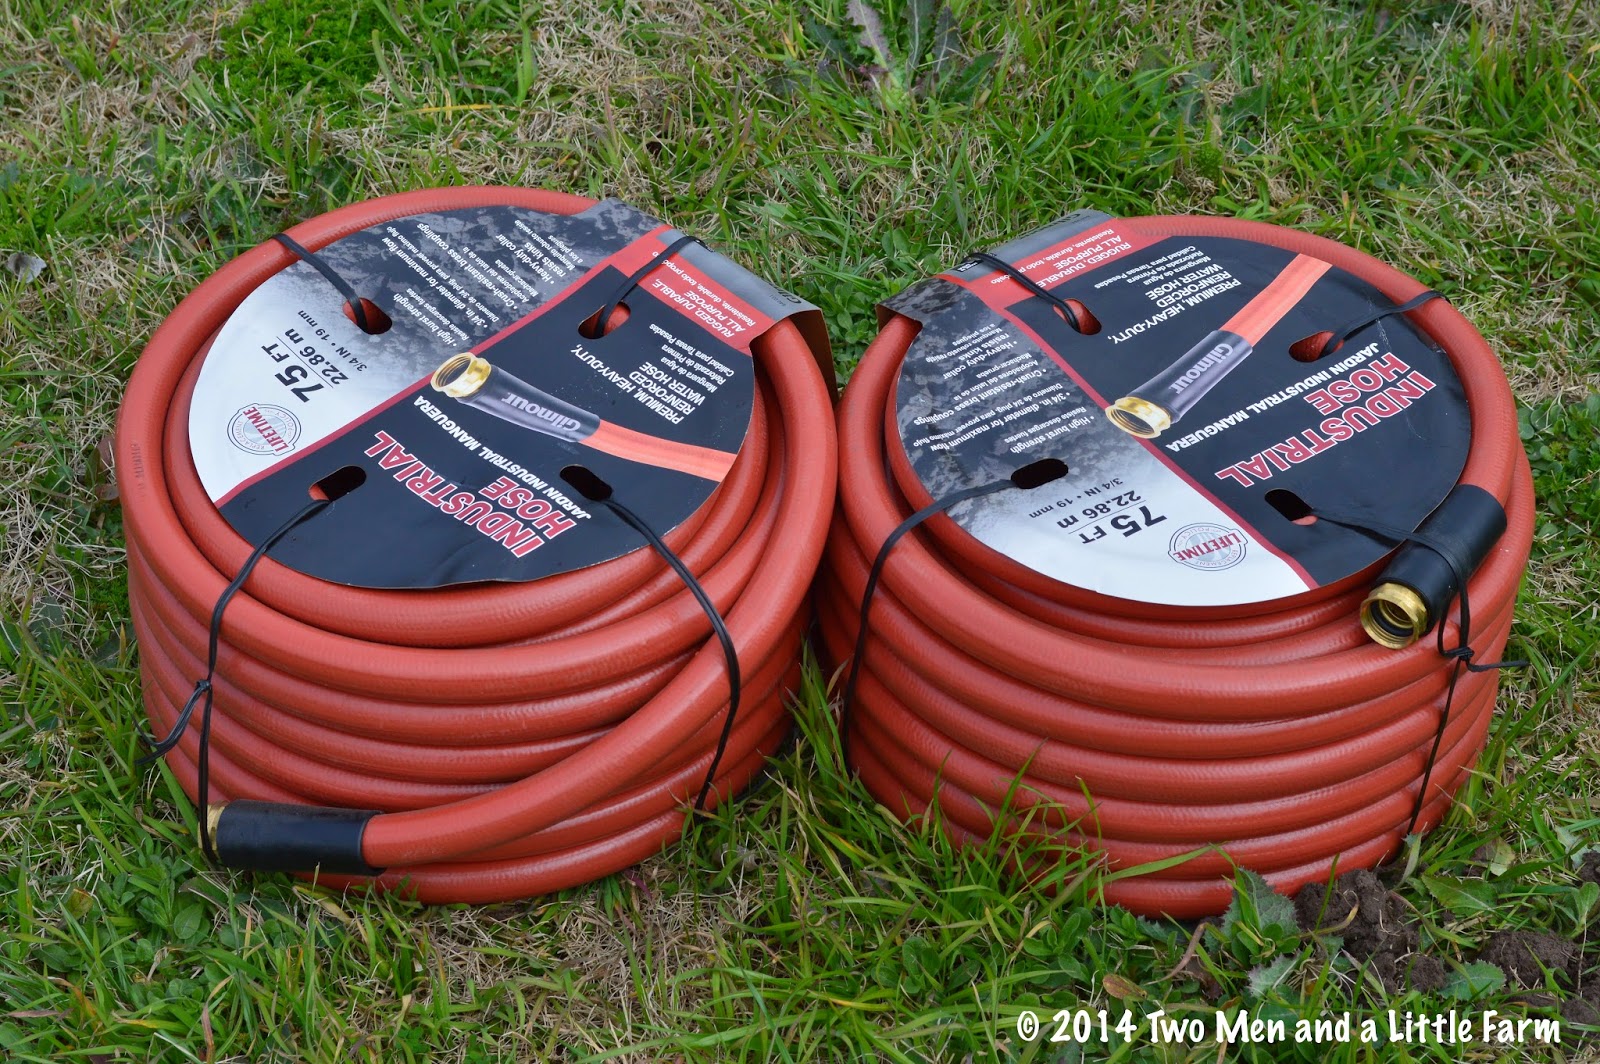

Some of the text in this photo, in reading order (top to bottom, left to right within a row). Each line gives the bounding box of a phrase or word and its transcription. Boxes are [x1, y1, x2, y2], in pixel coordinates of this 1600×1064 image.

[513, 218, 534, 235] resiste
[529, 232, 554, 250] robusto
[415, 222, 516, 307] Crush-resistant brass couplings
[465, 250, 477, 259] de
[492, 233, 553, 282] Heavy-duty collar
[522, 241, 567, 277] resists kinks
[567, 251, 580, 260] los
[1024, 259, 1045, 270] todo
[1051, 234, 1121, 269] ALL PURPOSE
[1083, 241, 1132, 265] RUGGED,
[1093, 244, 1196, 289] Calidad para Tareas Pesadas
[1125, 250, 1203, 283] Reforzada de Primera
[1142, 255, 1211, 286] Manguera de Agua
[380, 236, 486, 326] 3/4 in. diameter for maximum flow
[434, 267, 451, 279] para
[485, 267, 498, 277] del
[679, 272, 697, 286] todo
[1144, 263, 1223, 300] WATER HOSE
[1153, 269, 1232, 308] REINFORCED
[404, 287, 426, 304] fuertes
[466, 295, 478, 304] de
[651, 278, 735, 338] RUGGED, DURABLE,
[682, 289, 746, 332] ALL PURPOSE
[693, 282, 722, 303] durable,
[1106, 277, 1241, 344] PREMIUM, HEAVY-DUTY,
[390, 292, 455, 344] High burst strength
[447, 323, 470, 340] Resiste
[282, 327, 349, 384] 22.86 m
[296, 309, 368, 372] 3/4 IN 19 mm
[646, 322, 734, 376] Calidad para Tareas Pesadas
[957, 332, 1010, 361] resists kinks
[260, 342, 325, 403] 75 FT
[658, 356, 718, 393] Manguera de Agua
[659, 343, 727, 384] Reforzada de Primera
[941, 341, 1014, 380] Heavy-duty collar
[1169, 343, 1233, 394] Gilmour
[569, 343, 684, 424] PREMIUM, HEAVY-DUTY,
[627, 369, 695, 415] REINFORCED
[637, 360, 705, 405] WATER HOSE
[912, 368, 1043, 426] Crush-resistant brass couplings
[959, 389, 971, 398] de
[985, 376, 999, 385] del
[1022, 394, 1034, 402] de
[1165, 342, 1378, 452] JARDIN INDUSTRIAL MANGUERA
[1302, 351, 1411, 416] HOSE
[241, 406, 289, 452] LIFETIME
[500, 392, 580, 431] Gilmour
[929, 392, 1067, 451] 3/4 in. diameter for maximum flow
[978, 408, 996, 420] para
[1213, 369, 1437, 487] INDUSTRIAL
[1008, 416, 1091, 455] High burst strength
[413, 395, 592, 519] JARDIN INDUSTRIAL MANGUERA
[362, 429, 546, 558] INDUSTRIAL
[477, 475, 577, 539] HOSE
[1027, 476, 1124, 519] 3/4 IN 19 mm
[1055, 489, 1141, 529] 22.86 m
[1078, 504, 1167, 545] 75 FT
[1172, 532, 1241, 561] LIFETIME
